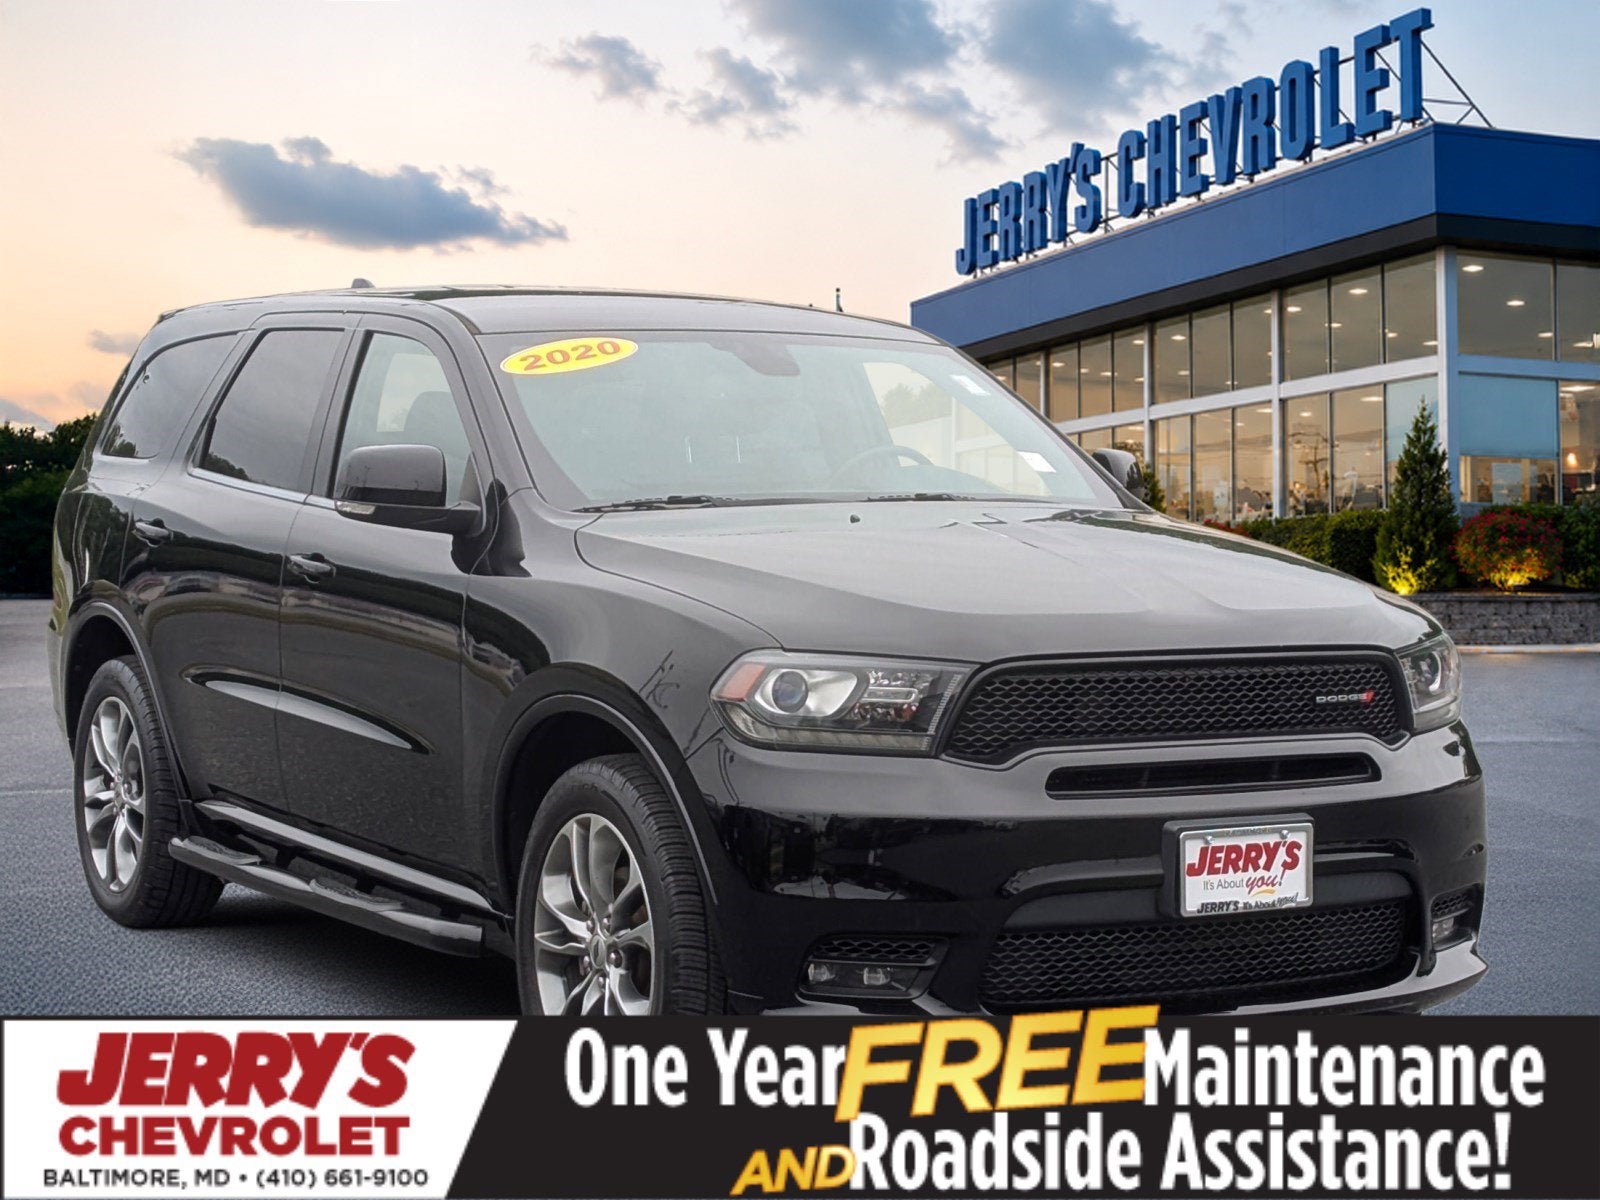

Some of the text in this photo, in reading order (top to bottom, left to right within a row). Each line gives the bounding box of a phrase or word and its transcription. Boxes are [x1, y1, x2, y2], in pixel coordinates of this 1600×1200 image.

[956, 8, 1434, 275] JERRY'S CHEVROLET
[519, 340, 621, 371] 2020
[1315, 693, 1368, 703] DODGE
[1186, 840, 1302, 877] JERRY'S
[1203, 881, 1215, 891] It's
[1216, 879, 1244, 890] About
[1197, 901, 1240, 914] JERRY'S
